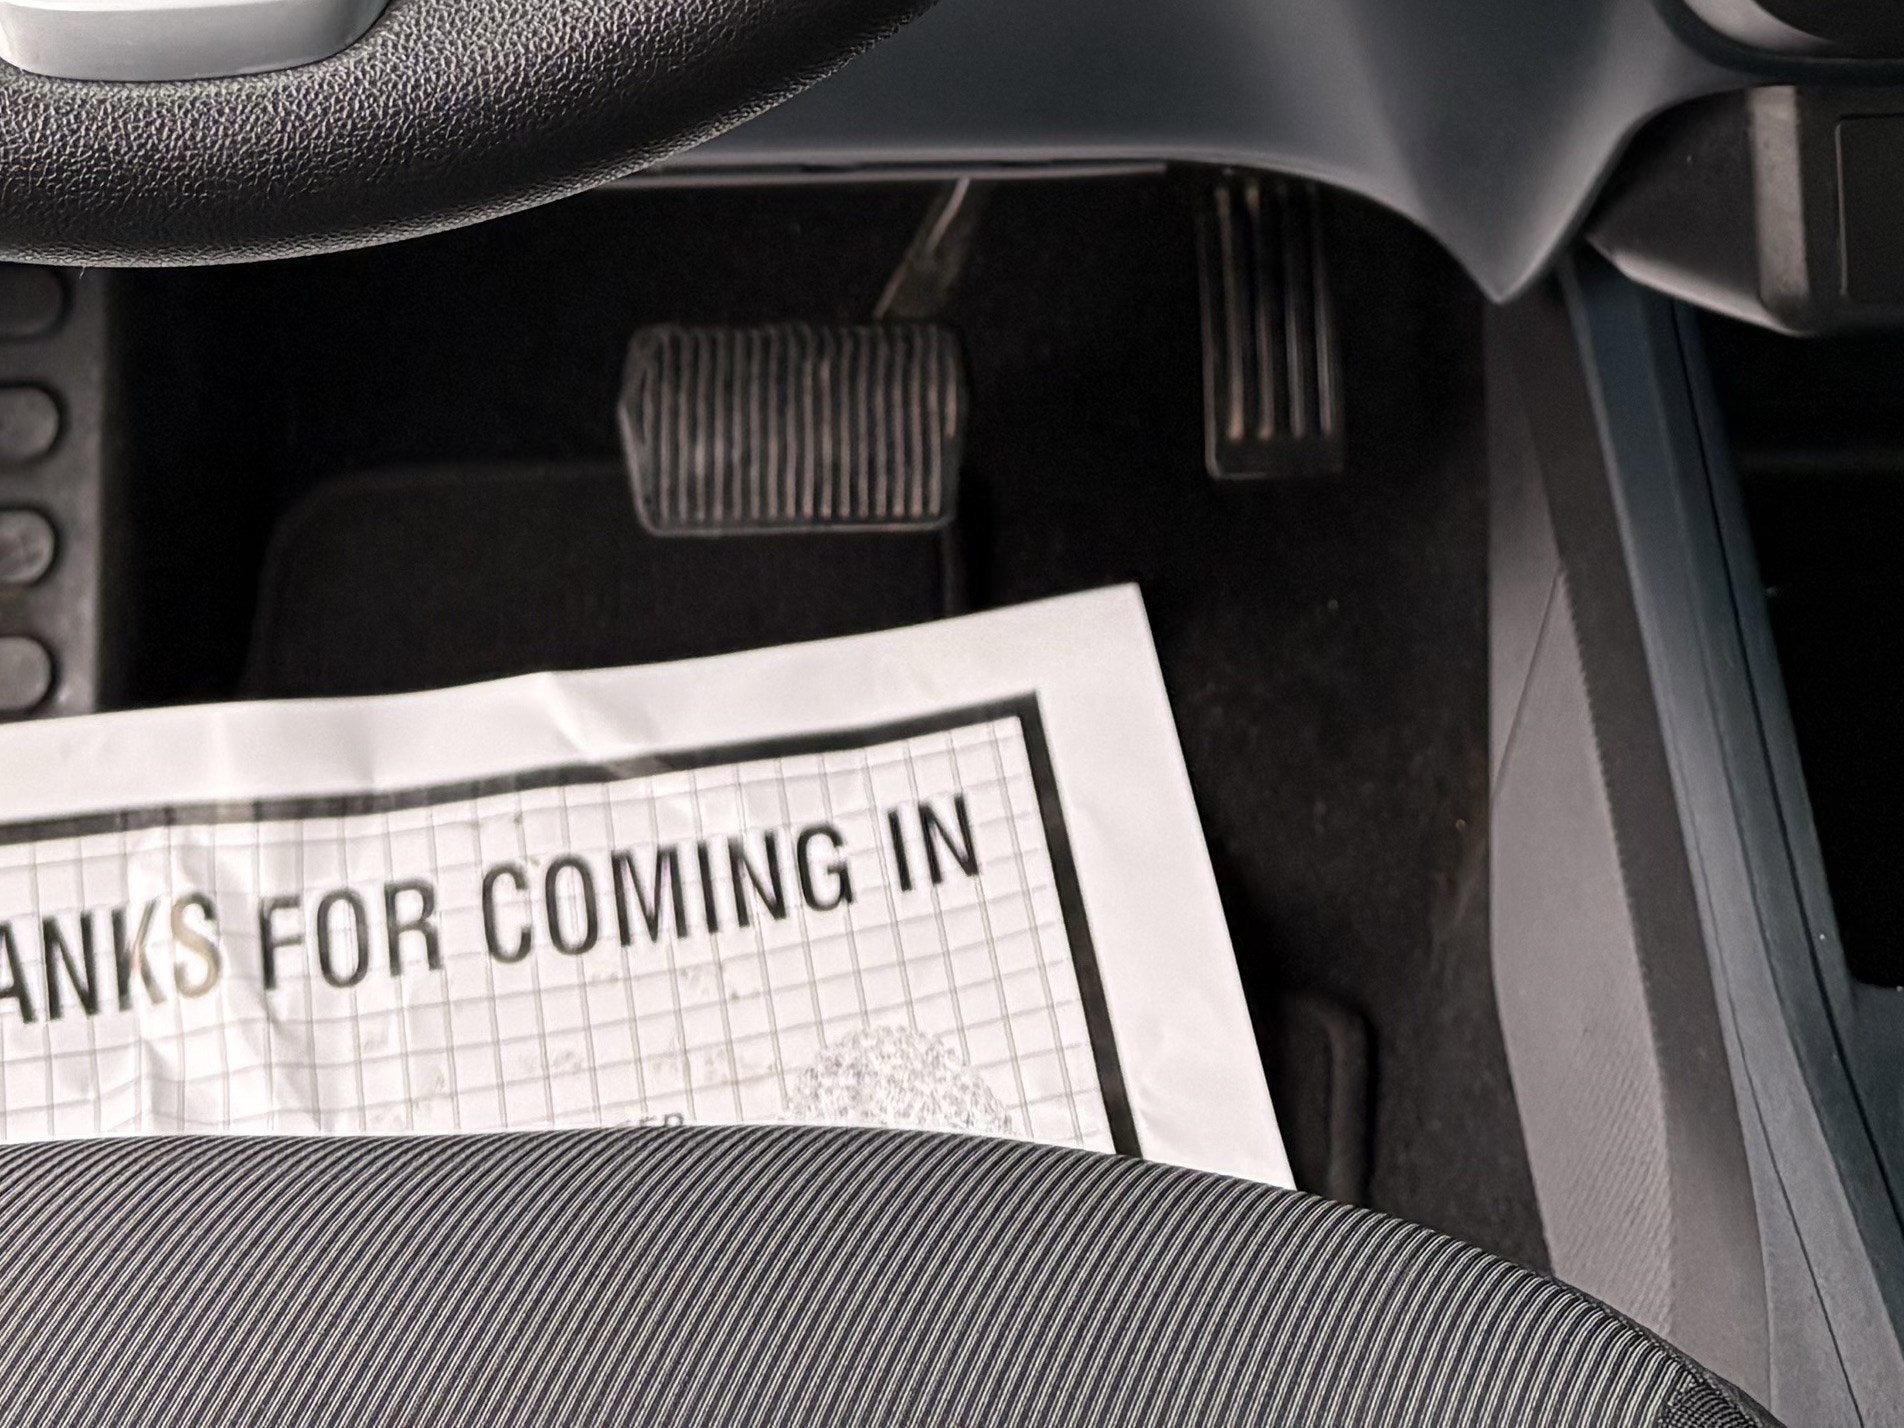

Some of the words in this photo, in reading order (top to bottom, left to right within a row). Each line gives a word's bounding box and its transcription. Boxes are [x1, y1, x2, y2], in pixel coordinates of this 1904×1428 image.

[258, 871, 446, 992] FOR
[480, 820, 854, 966] COMING
[887, 794, 982, 893] IN
